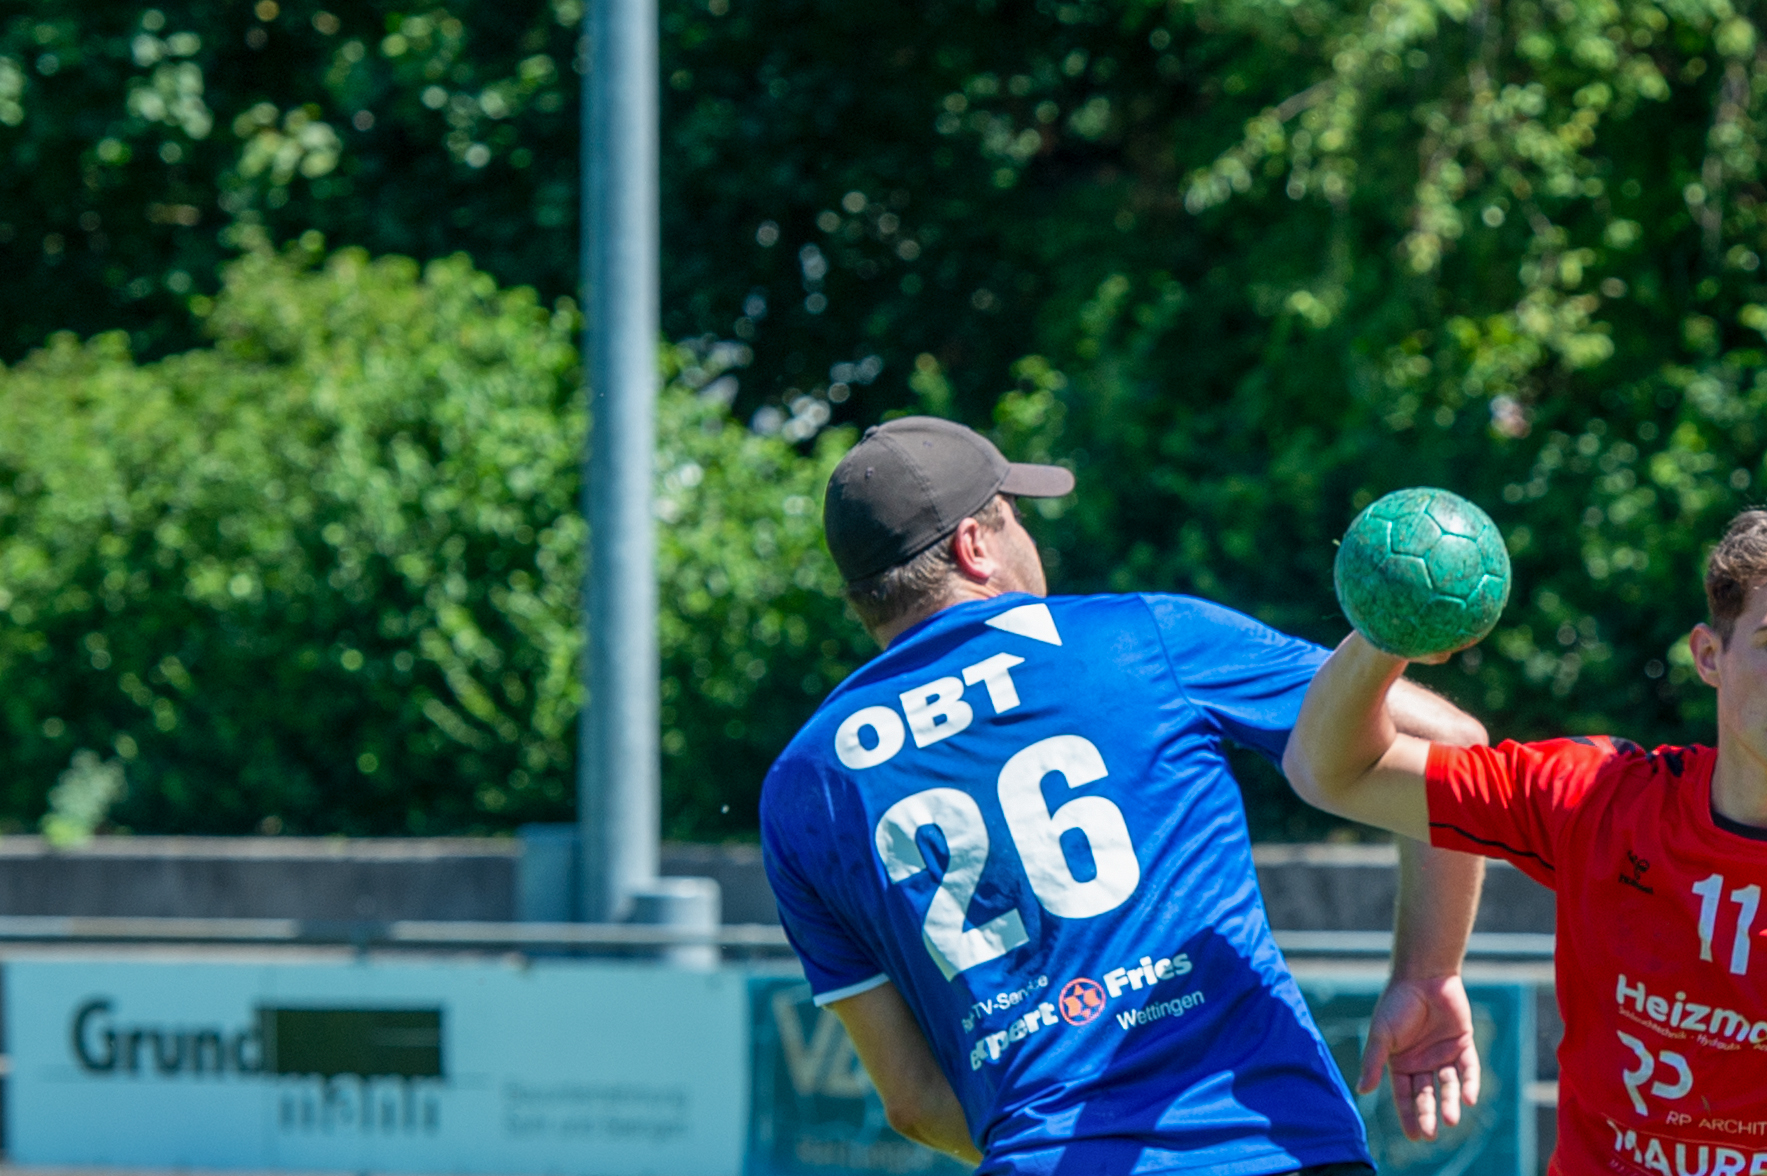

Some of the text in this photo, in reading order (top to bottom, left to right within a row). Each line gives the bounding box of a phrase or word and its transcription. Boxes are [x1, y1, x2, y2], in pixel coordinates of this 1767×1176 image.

[835, 653, 1025, 770] OBT
[875, 734, 1141, 982] 26
[1691, 873, 1762, 976] 11
[1103, 953, 1193, 998] Fries
[1116, 991, 1206, 1031] Wettingen
[70, 995, 268, 1079] Grund
[1665, 1110, 1692, 1127] RP
